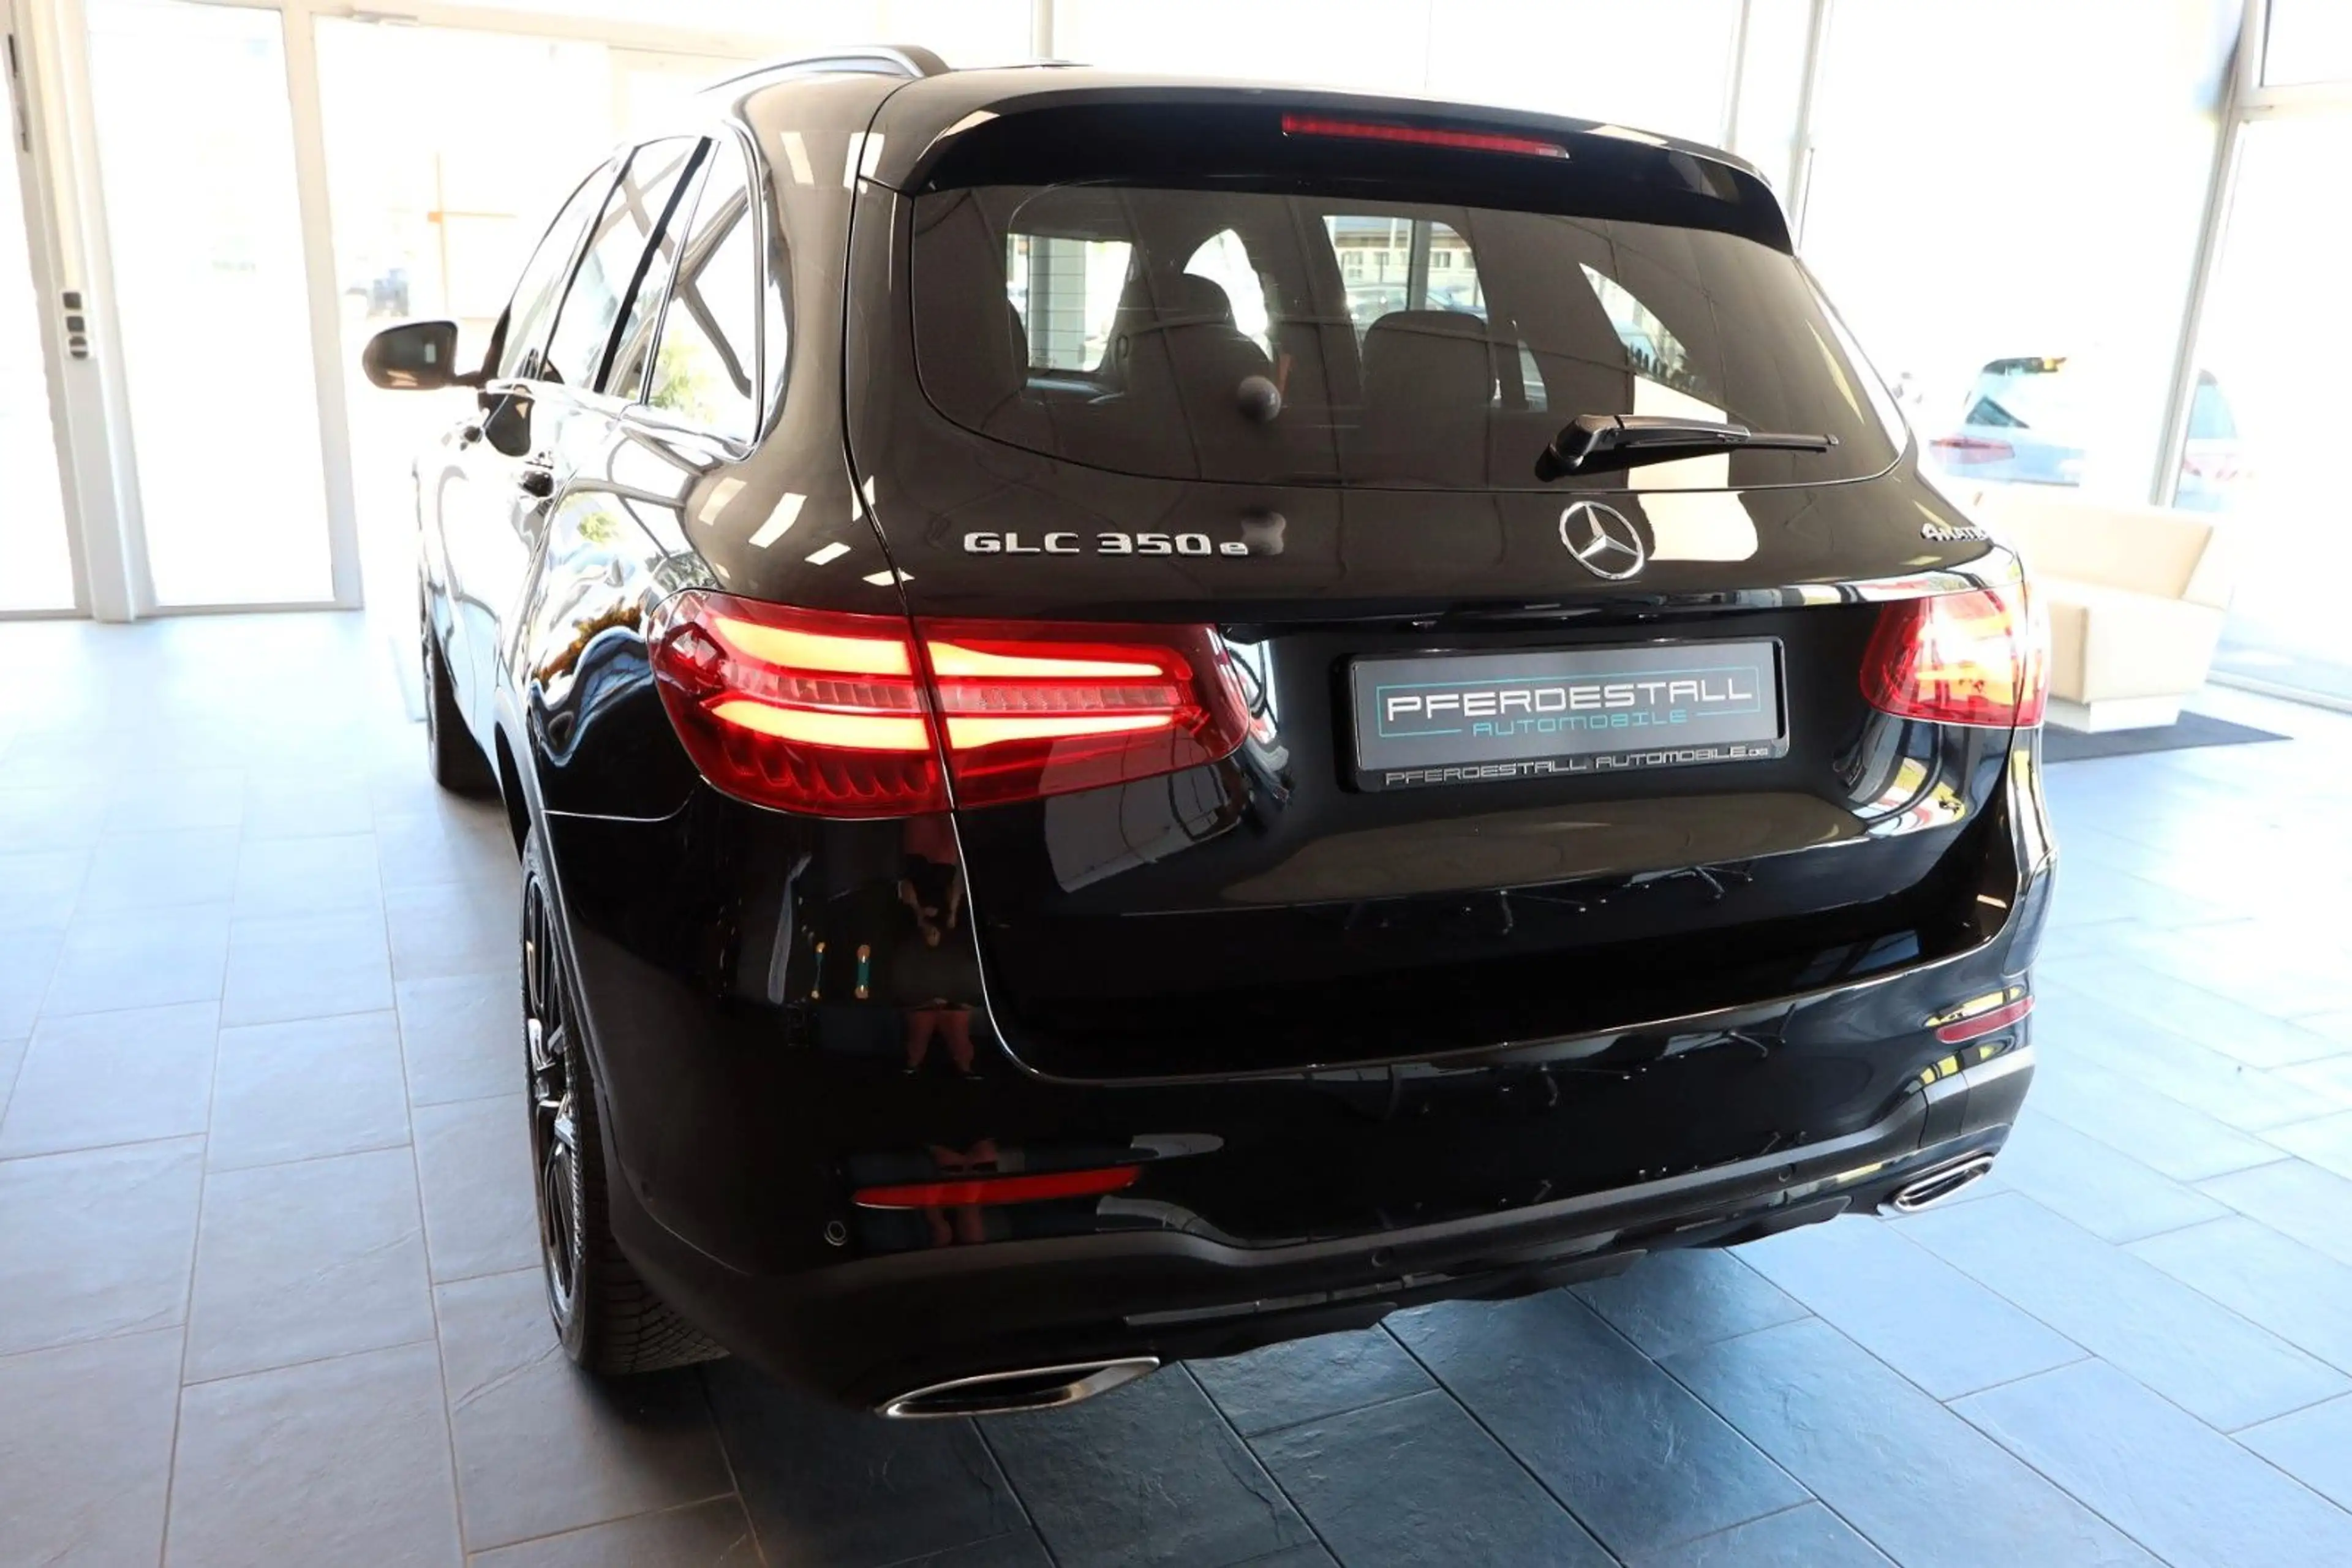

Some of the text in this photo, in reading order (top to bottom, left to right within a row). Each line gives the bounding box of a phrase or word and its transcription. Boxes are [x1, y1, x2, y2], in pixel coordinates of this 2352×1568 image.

[963, 532, 1080, 553] GLC
[1387, 678, 1752, 722] PFERDESTALL
[1472, 709, 1687, 737] AUTOMOBILE
[1385, 759, 1587, 786] PFERDESTALL
